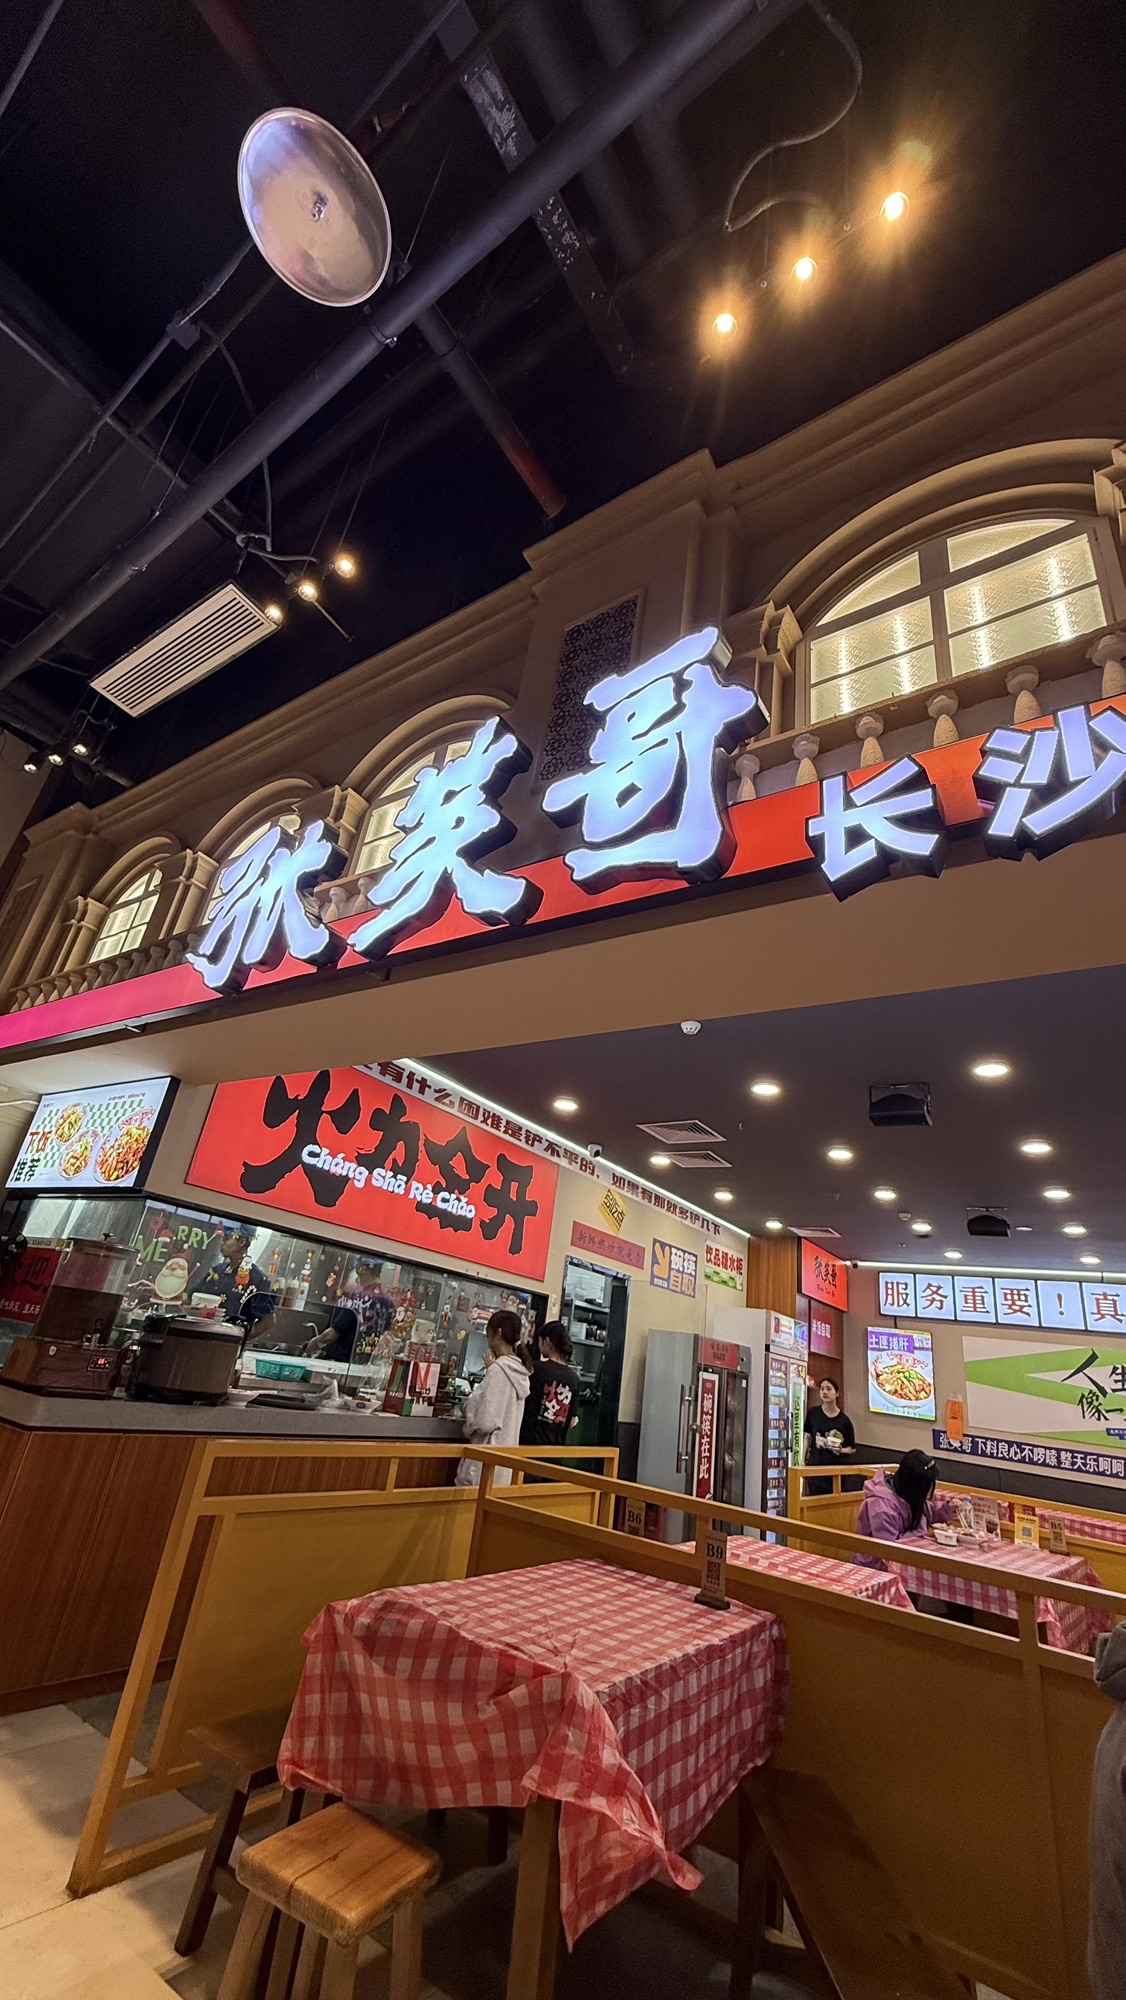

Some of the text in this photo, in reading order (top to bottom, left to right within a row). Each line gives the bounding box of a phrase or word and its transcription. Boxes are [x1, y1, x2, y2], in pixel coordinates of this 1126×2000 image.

[185, 626, 1126, 992] 张笑哥 长沙
[240, 1069, 538, 1256] 火力全开
[362, 1061, 721, 1236] 有什么困难是铲不平的， 如果有那就多铲几下
[302, 1144, 369, 1188] Cháng
[408, 1182, 434, 1204] Rè
[671, 1247, 696, 1276] 碗筷
[669, 1270, 694, 1298] 自取
[869, 1334, 909, 1351] 土匪猪肝
[699, 1392, 713, 1479] 碗筷在此
[976, 1437, 1058, 1466] 下料良心不啰嗦
[1060, 1450, 1125, 1477] 整天乐呵呵
[628, 1510, 642, 1524] B6
[706, 1543, 723, 1560] B9
